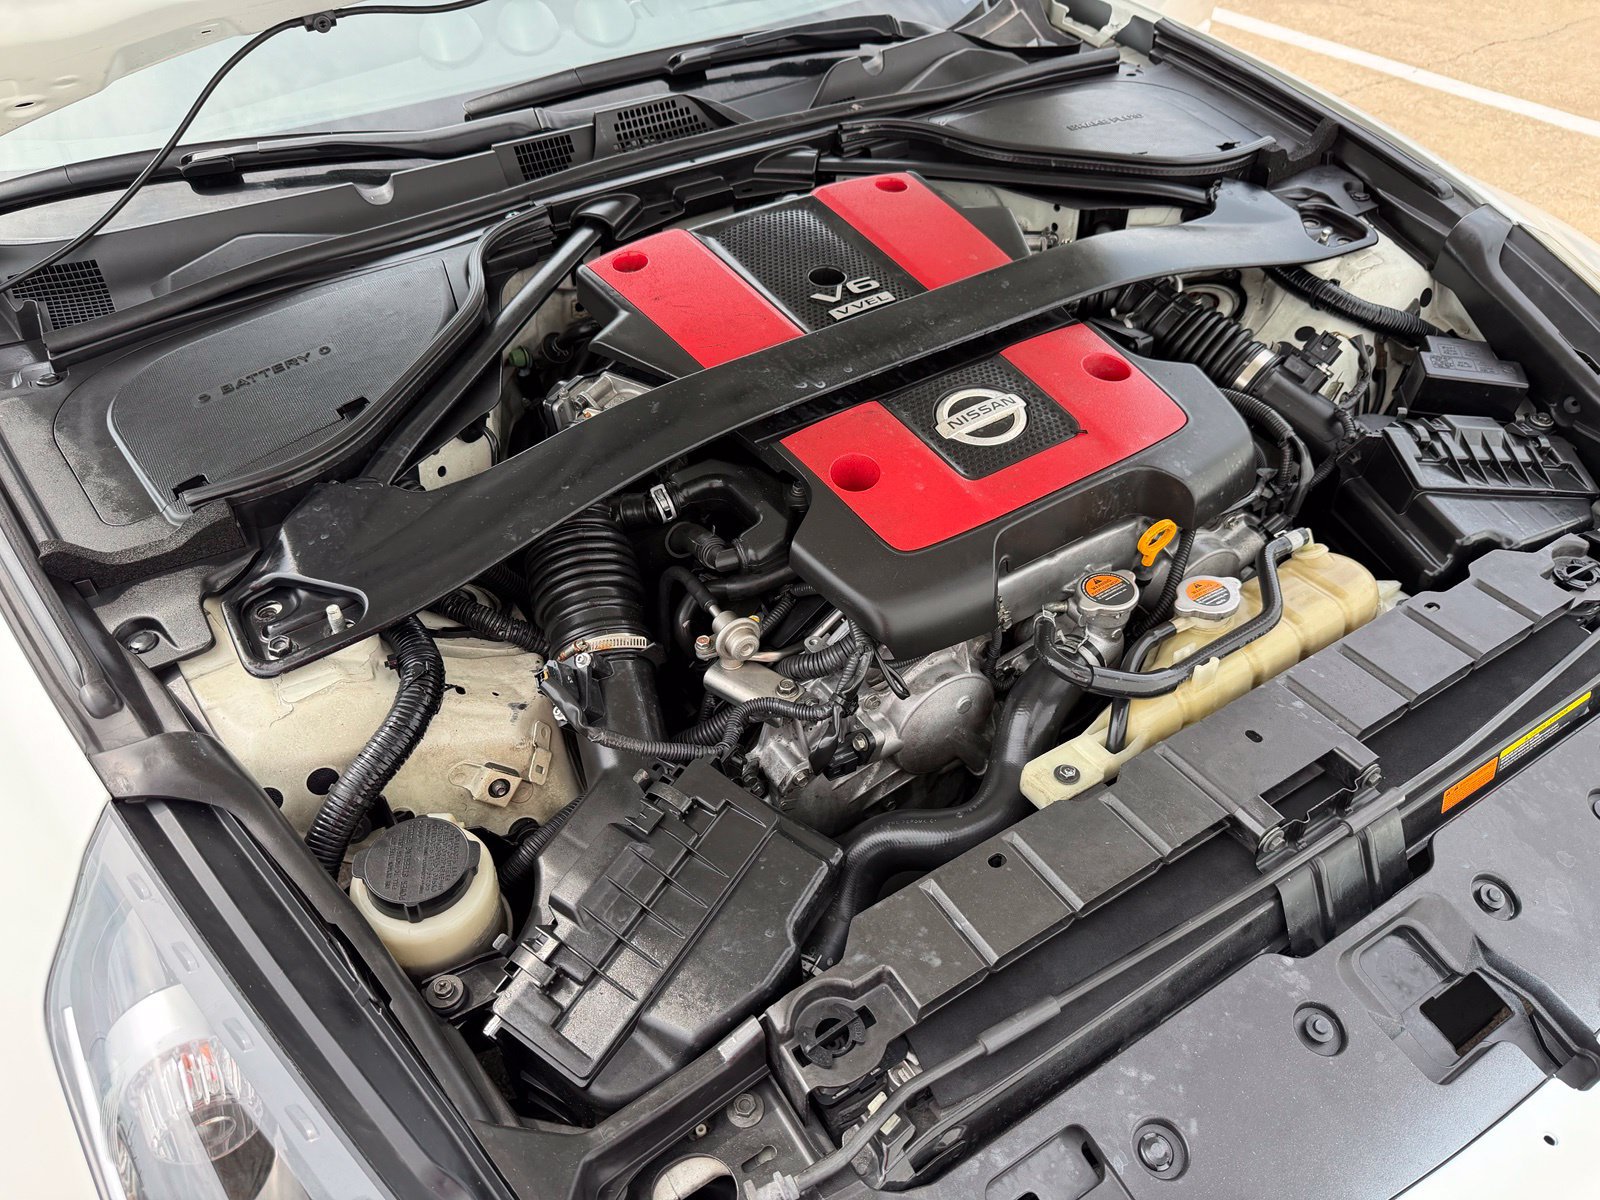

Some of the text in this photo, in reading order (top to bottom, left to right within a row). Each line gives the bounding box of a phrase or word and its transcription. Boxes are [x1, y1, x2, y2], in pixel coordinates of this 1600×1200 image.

[809, 276, 881, 303] V6
[836, 296, 889, 315] VVEL
[220, 352, 311, 395] BATTERY
[946, 396, 1017, 430] NISSAN
